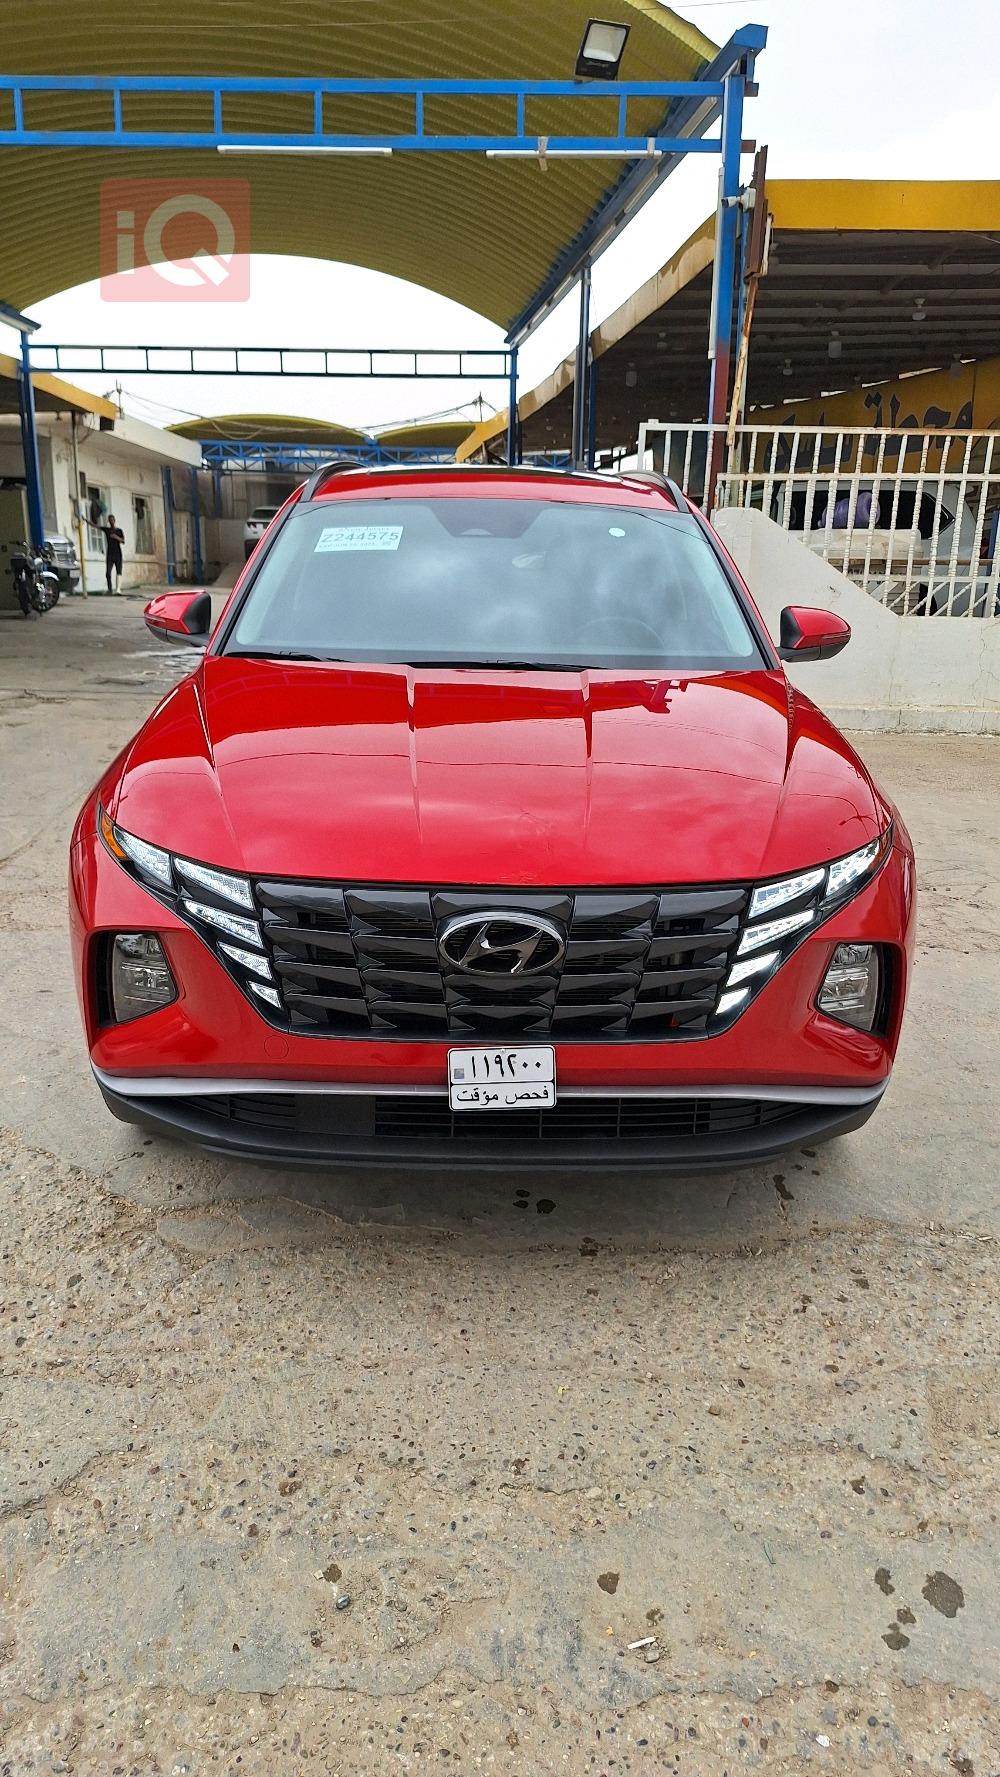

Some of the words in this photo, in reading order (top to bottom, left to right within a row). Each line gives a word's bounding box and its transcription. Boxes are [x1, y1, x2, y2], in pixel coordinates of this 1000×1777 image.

[471, 1053, 541, 1078] ١١٩٢٠٠
[456, 1087, 499, 1106] مؤقت
[505, 1085, 549, 1105] فحص
